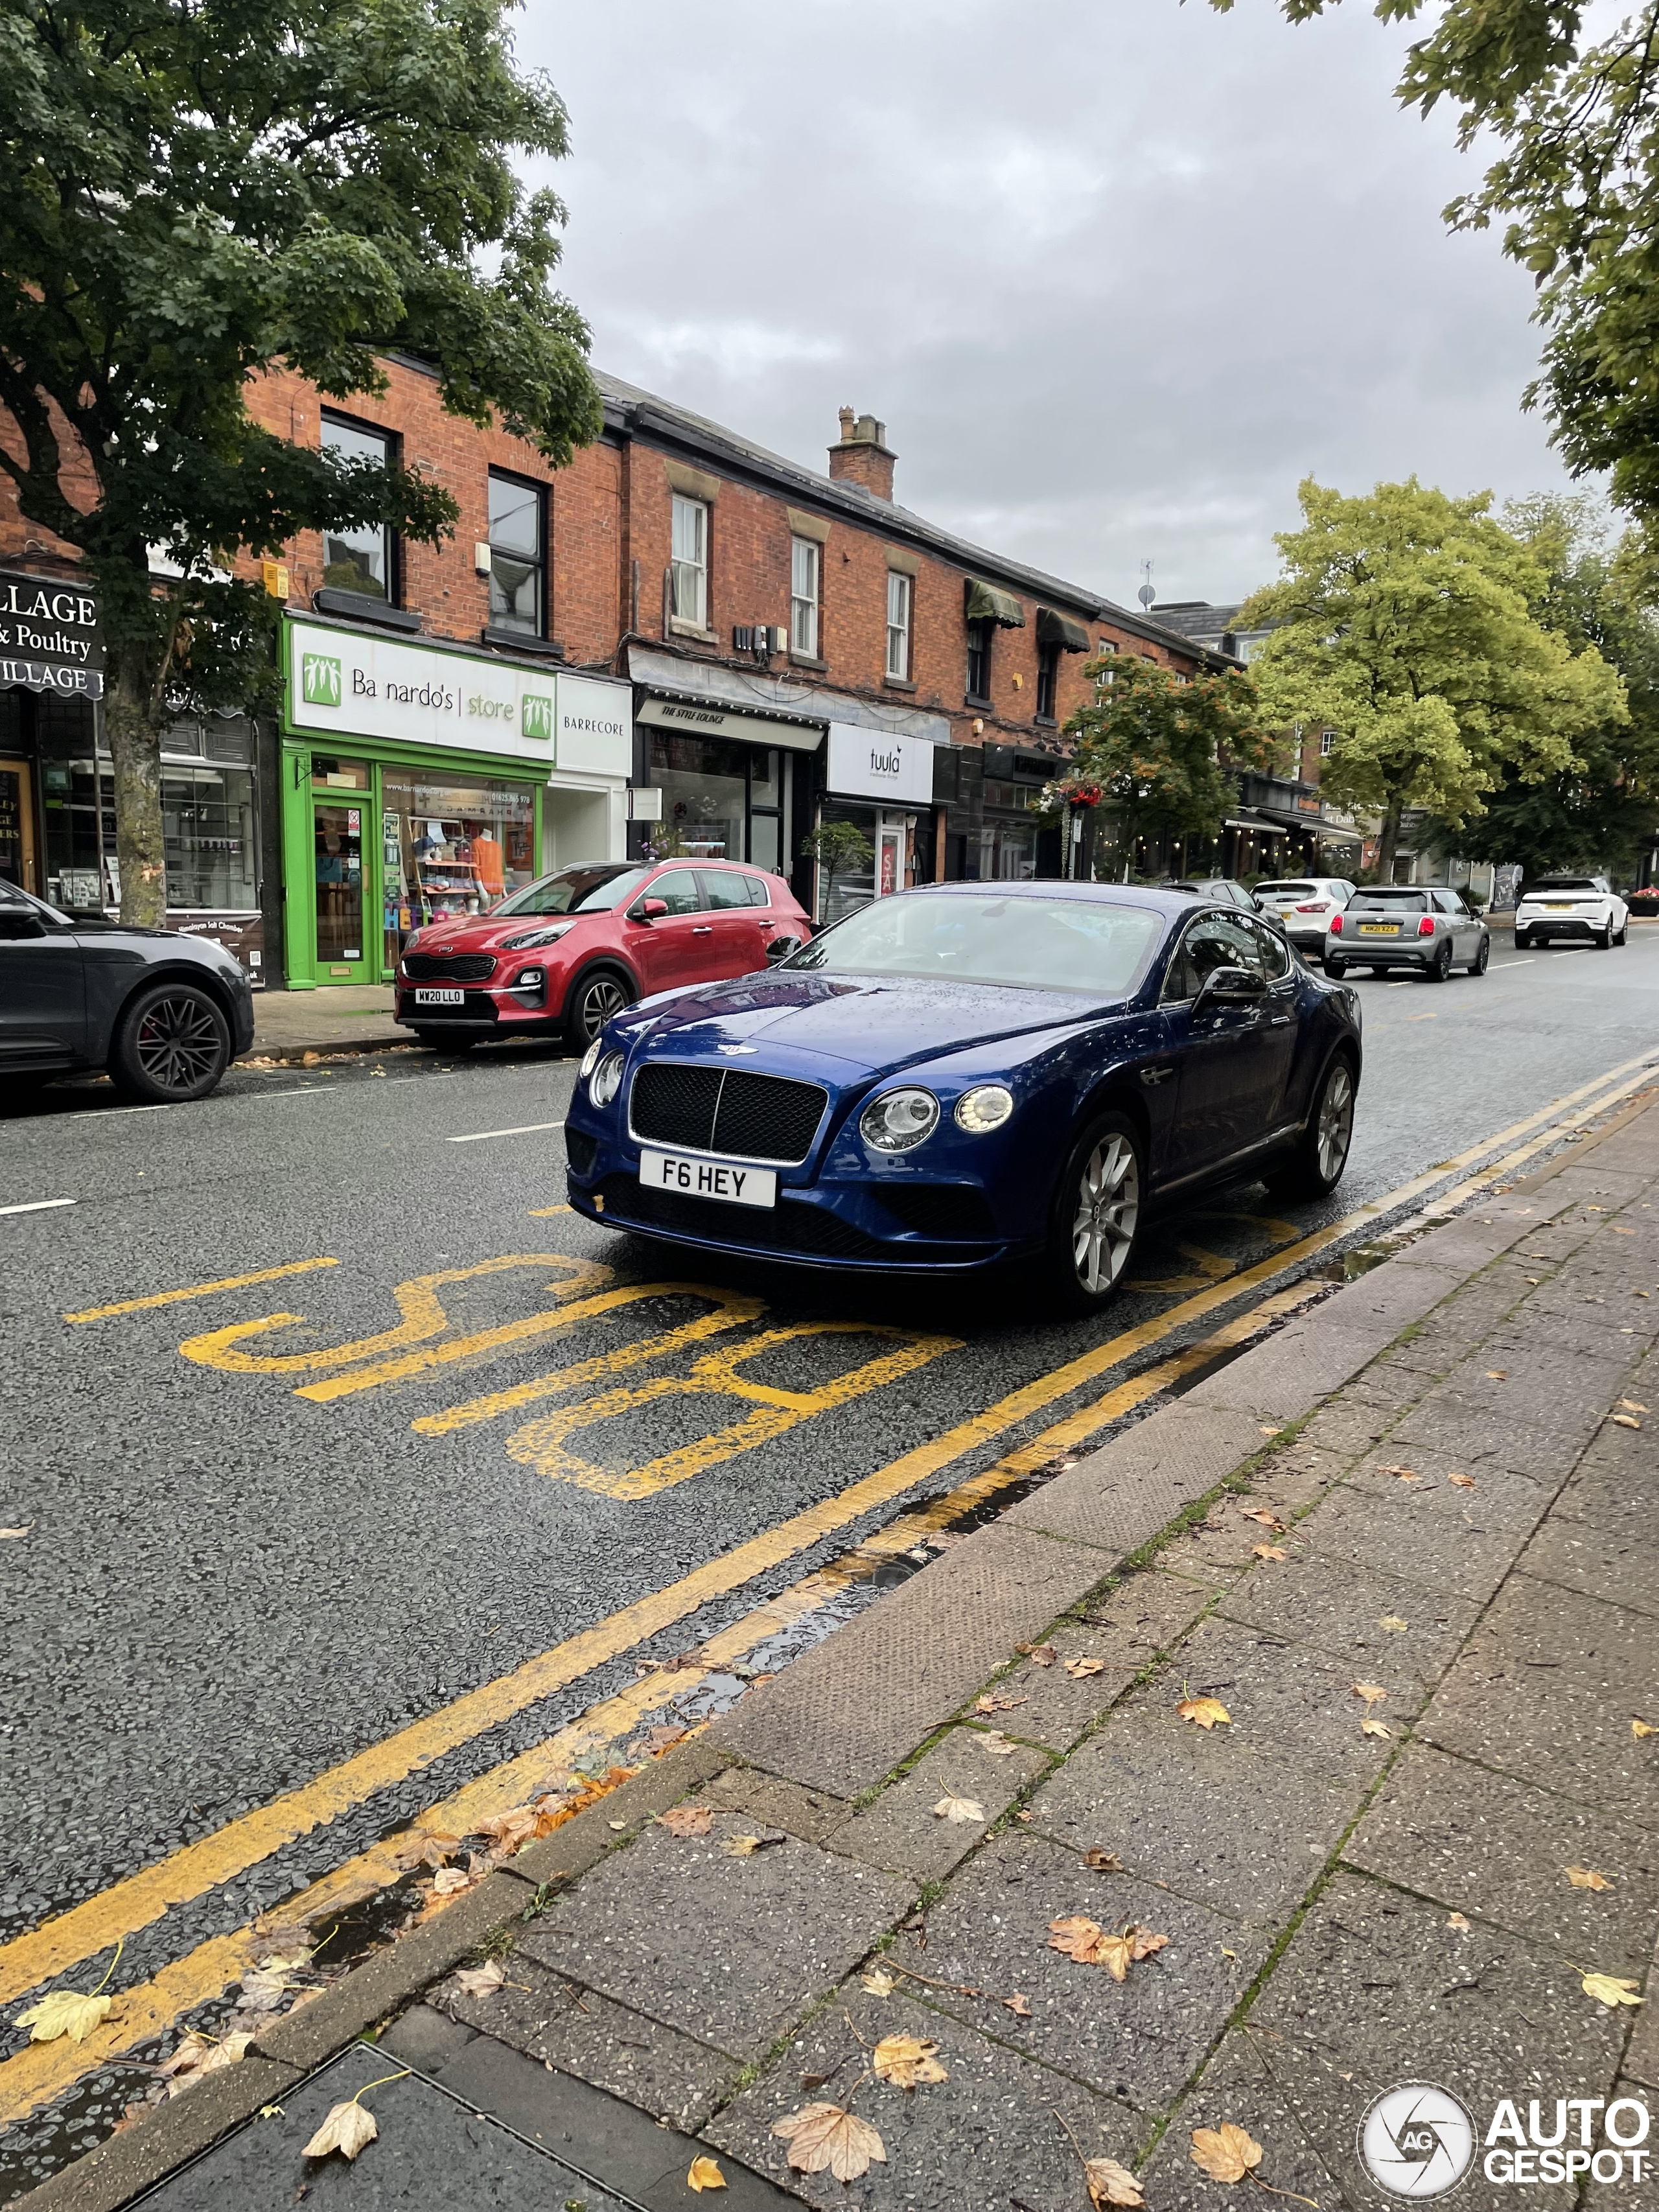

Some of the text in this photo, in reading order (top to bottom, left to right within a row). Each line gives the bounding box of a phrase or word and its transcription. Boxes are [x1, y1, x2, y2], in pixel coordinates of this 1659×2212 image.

[16, 624, 91, 662] Poultry
[0, 660, 87, 690] ILLAGE
[468, 694, 514, 720] store
[662, 706, 726, 725] THE STYLE LOUNGE
[564, 716, 624, 736] BARRECORE
[871, 748, 899, 773] tuula
[492, 792, 508, 802] 01625
[508, 794, 519, 803] 865
[520, 795, 530, 804] 978
[178, 922, 207, 933] Himalayan
[218, 922, 244, 933] Chamber
[663, 1159, 747, 1197] F6 HEY
